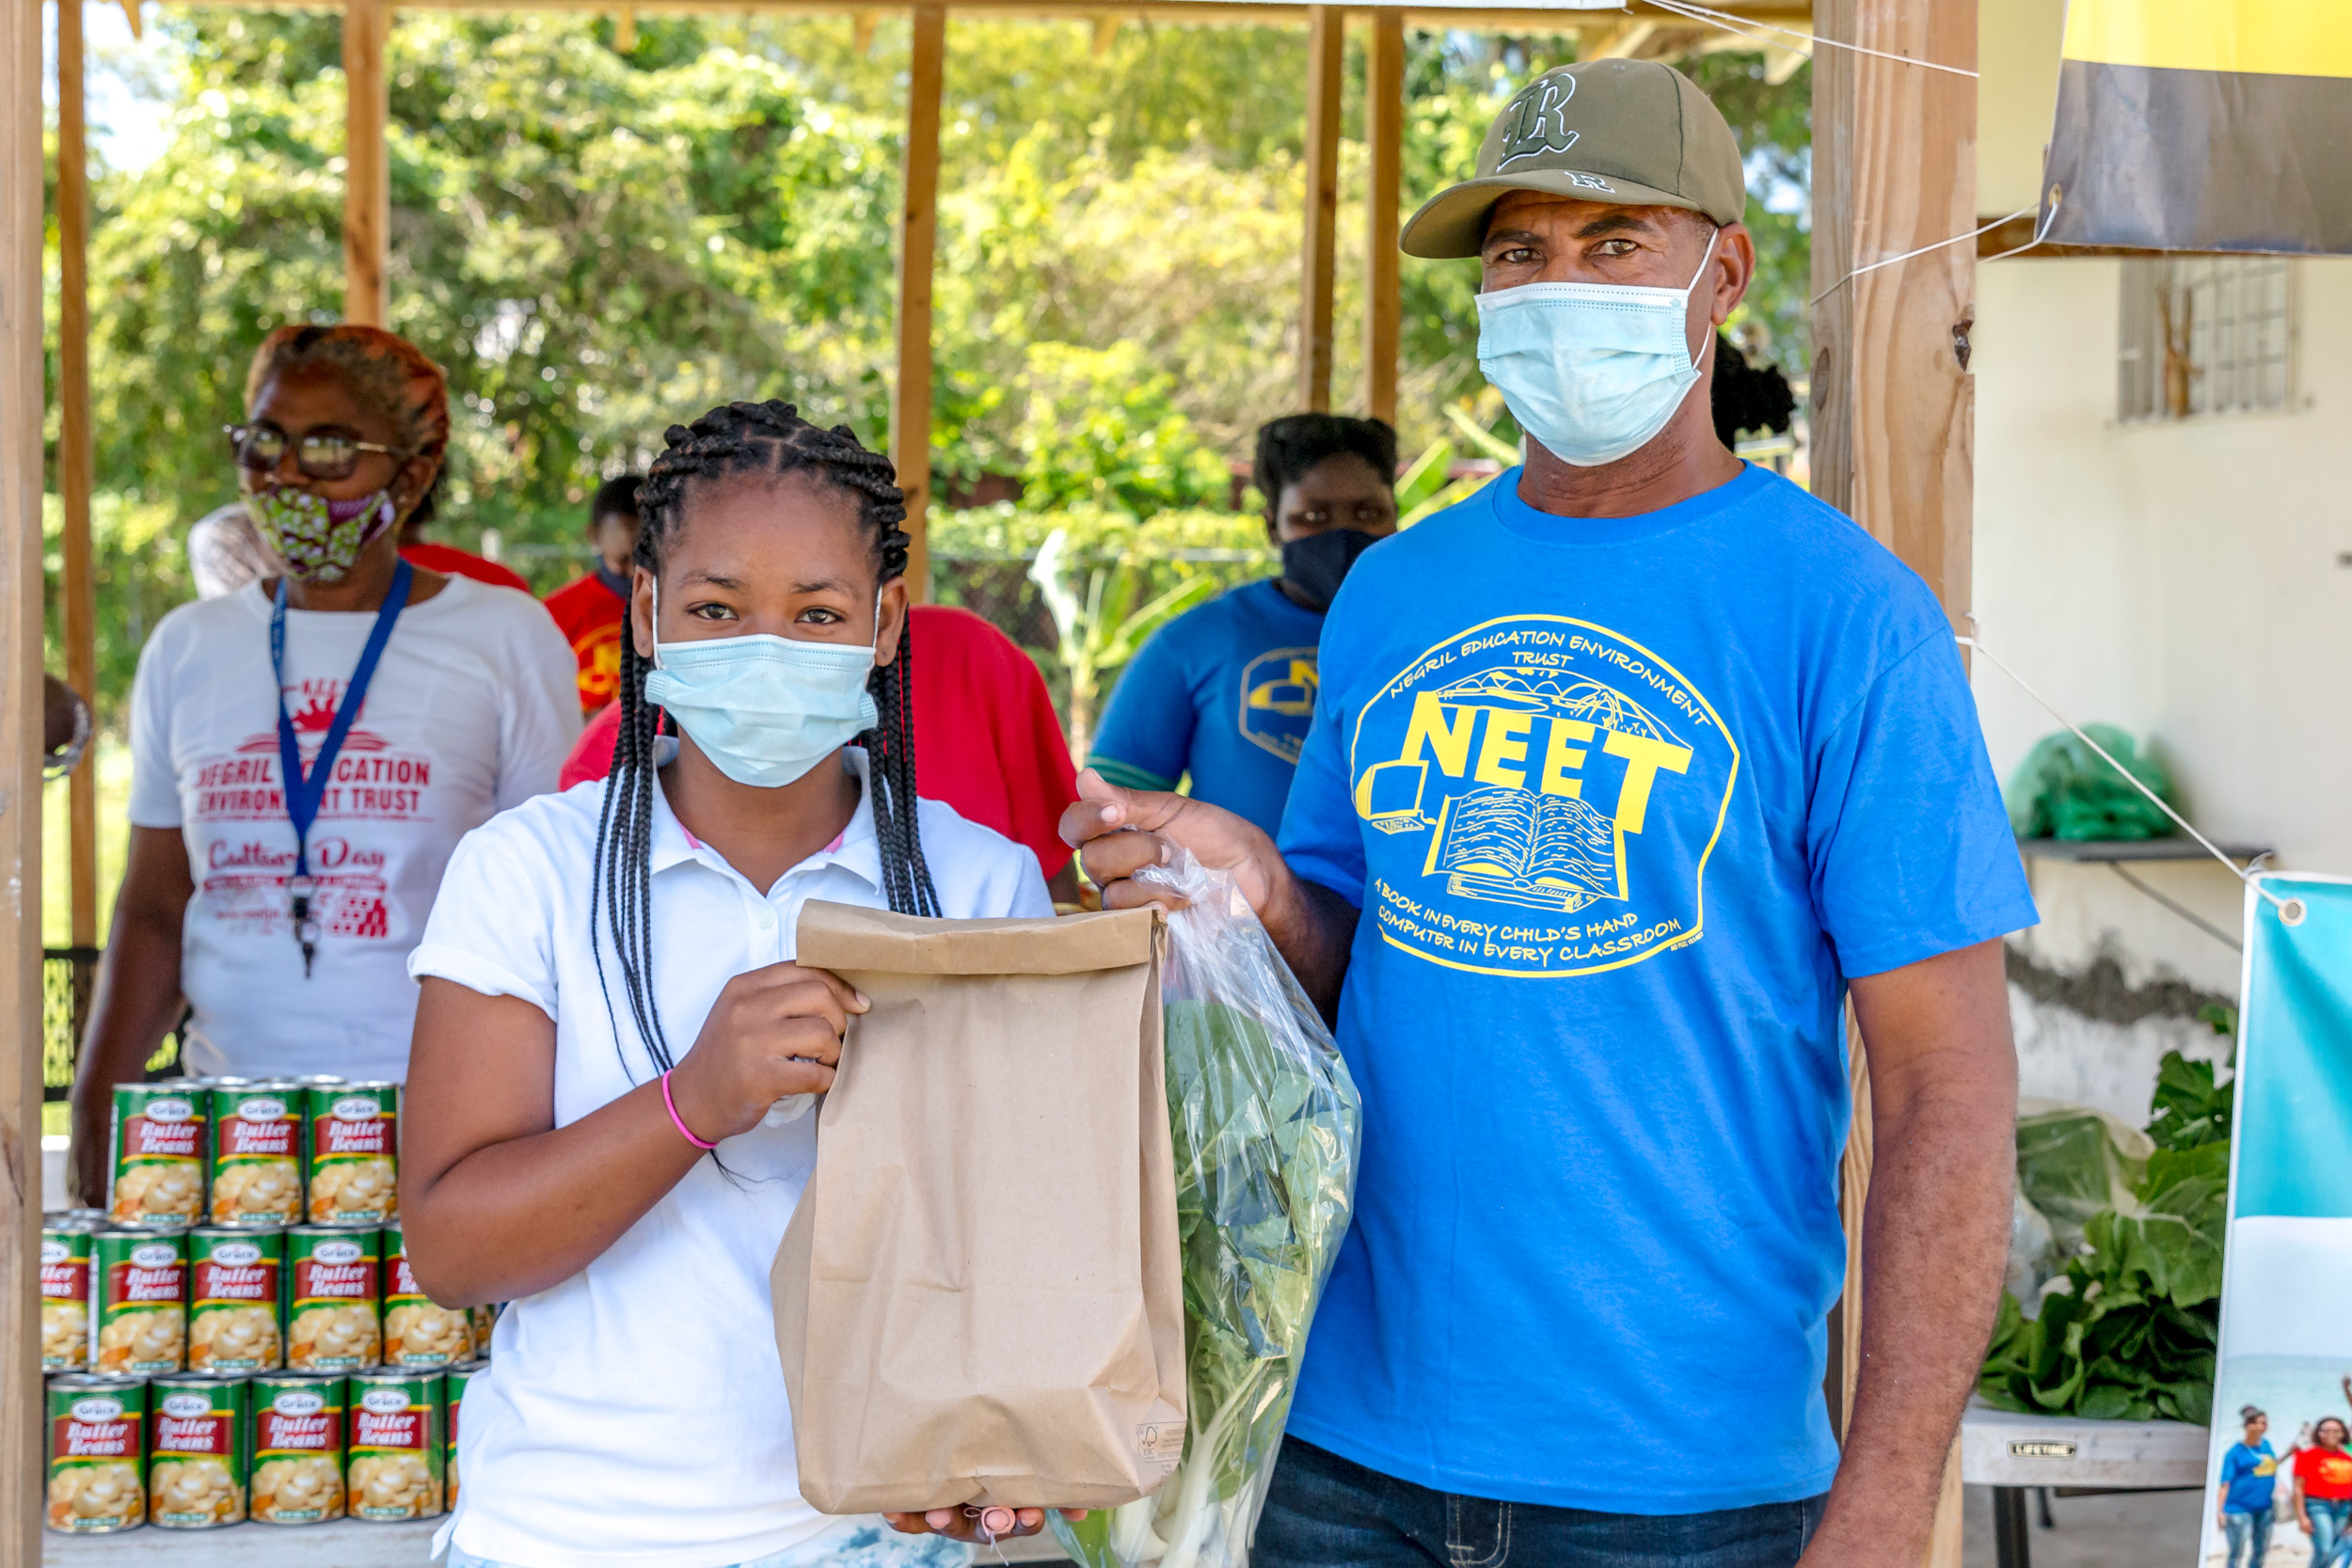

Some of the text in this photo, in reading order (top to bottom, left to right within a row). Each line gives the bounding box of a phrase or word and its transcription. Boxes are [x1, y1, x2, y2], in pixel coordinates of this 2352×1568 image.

[1496, 72, 1581, 173] R
[1563, 170, 1616, 194] R
[1512, 652, 1575, 668] TRUST
[1391, 630, 1712, 726] NEGRIL EDUCATION ENVIRONMENT
[1400, 690, 1693, 834] NEET
[350, 788, 421, 812] TRUST
[311, 835, 386, 873] Day
[1375, 878, 1638, 942] A BOOK IN EVERY CHILD'S HAND
[1378, 905, 1454, 950] COMPUTER
[1459, 939, 1478, 955] IN
[1484, 942, 1553, 967] EVERY
[1559, 918, 1682, 962] CLASSROOM
[140, 1120, 198, 1139] Butter
[233, 1120, 291, 1138] Butter
[328, 1120, 386, 1138] Butter
[140, 1136, 195, 1153] Beans
[235, 1136, 289, 1153] Beans
[329, 1135, 383, 1152] Beans
[125, 1267, 181, 1286] Butter
[206, 1266, 266, 1283] Butter
[309, 1263, 367, 1281] Butter
[127, 1283, 180, 1300] Beans
[208, 1281, 264, 1298] Beans
[310, 1279, 365, 1296] Beans
[158, 1417, 217, 1434] Butter
[269, 1415, 329, 1433] Butter
[357, 1412, 416, 1430] Butter
[67, 1422, 128, 1440] Butter
[270, 1431, 326, 1449] Beans
[358, 1428, 413, 1446] Beans
[68, 1438, 126, 1455] Beans
[159, 1433, 215, 1450] Beans
